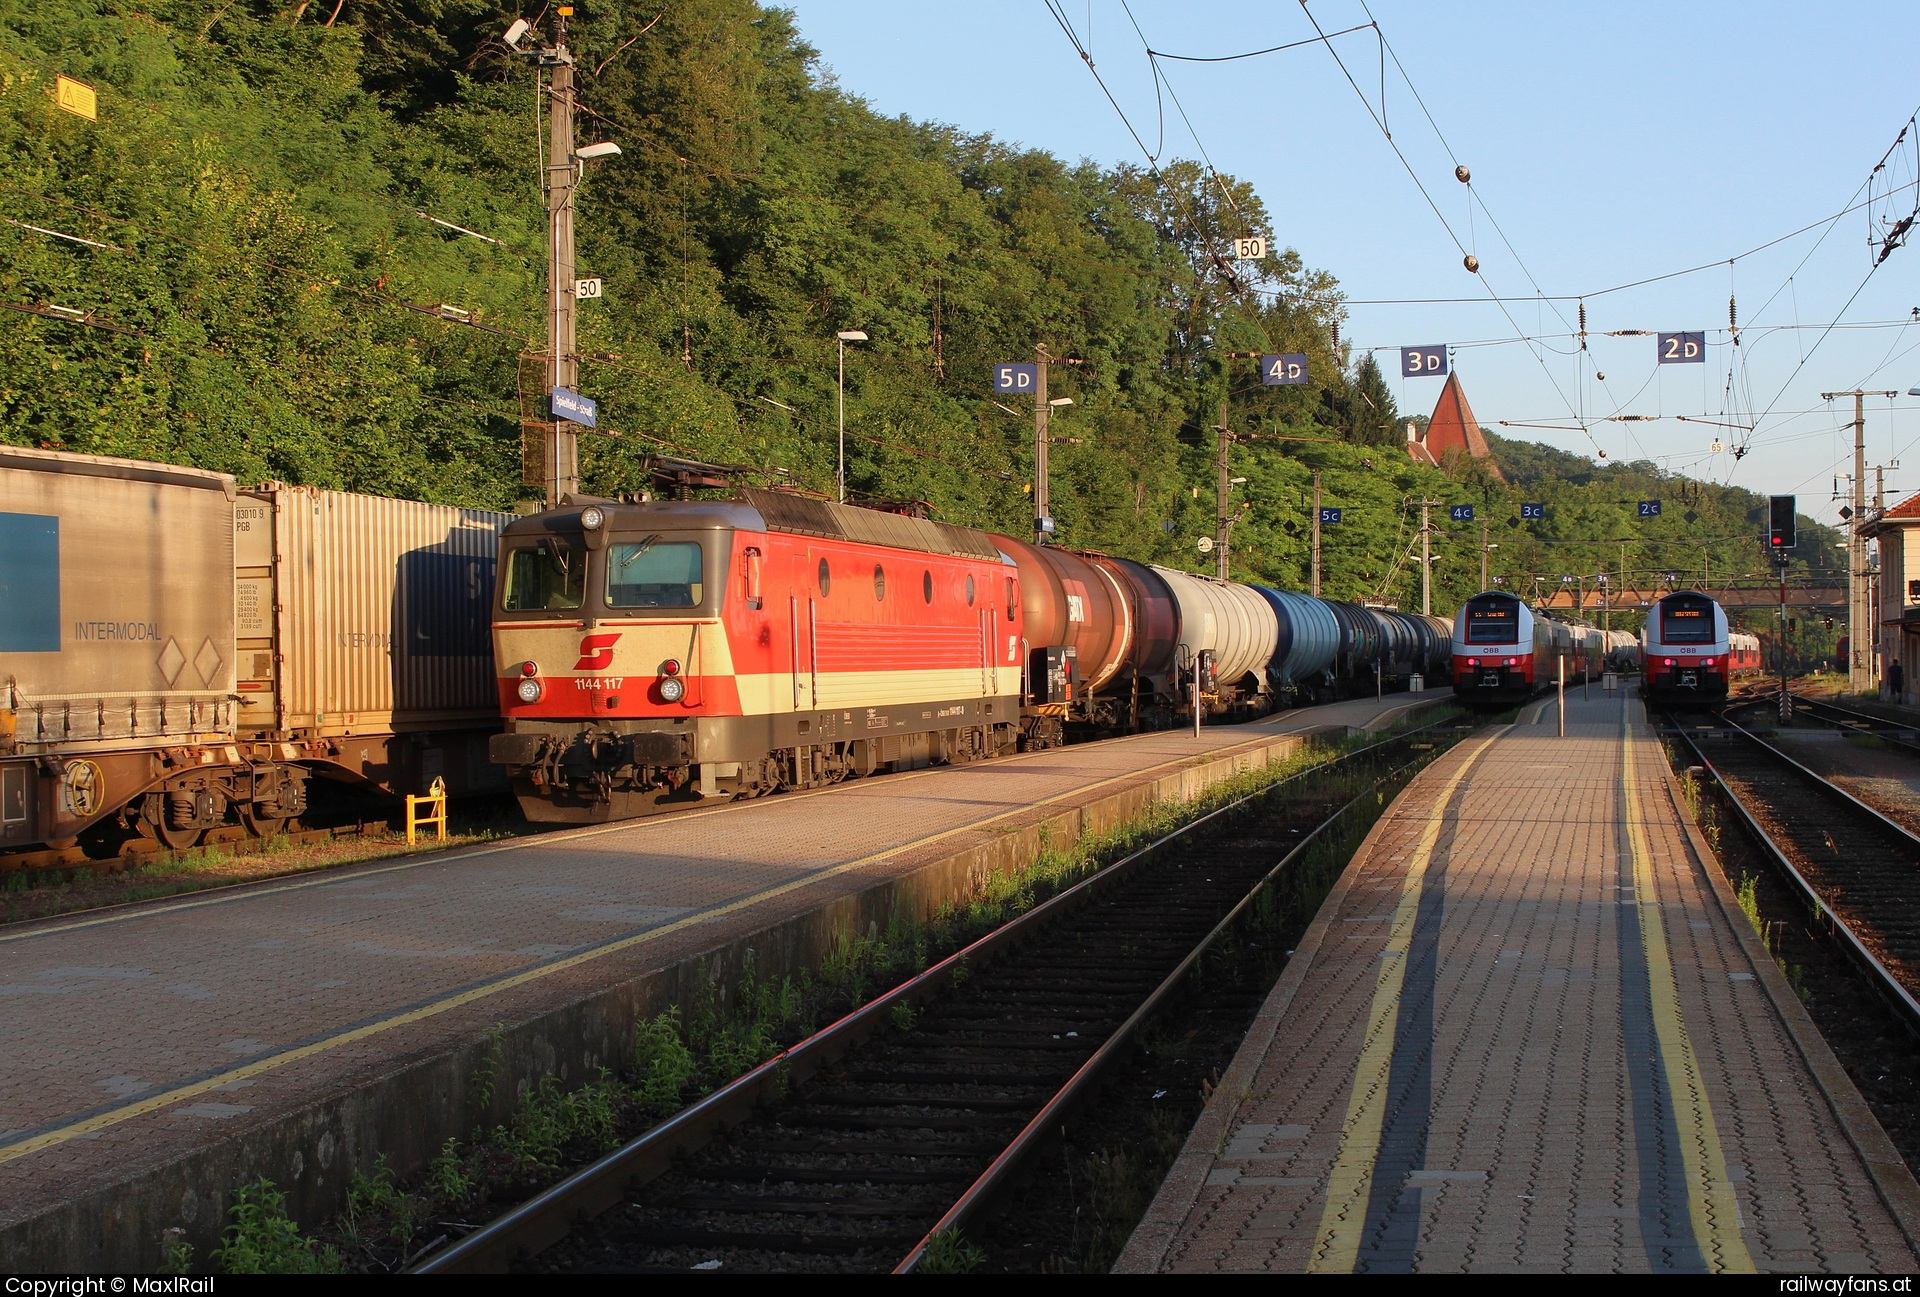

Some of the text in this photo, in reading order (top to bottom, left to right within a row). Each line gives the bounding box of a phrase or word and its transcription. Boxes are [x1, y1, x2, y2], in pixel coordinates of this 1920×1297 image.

[1241, 240, 1260, 257] 50
[580, 280, 597, 296] 50
[1711, 443, 1722, 452] 65
[259, 508, 264, 519] 9
[75, 621, 162, 641] INTERMODAL
[575, 677, 624, 690] 1144 117
